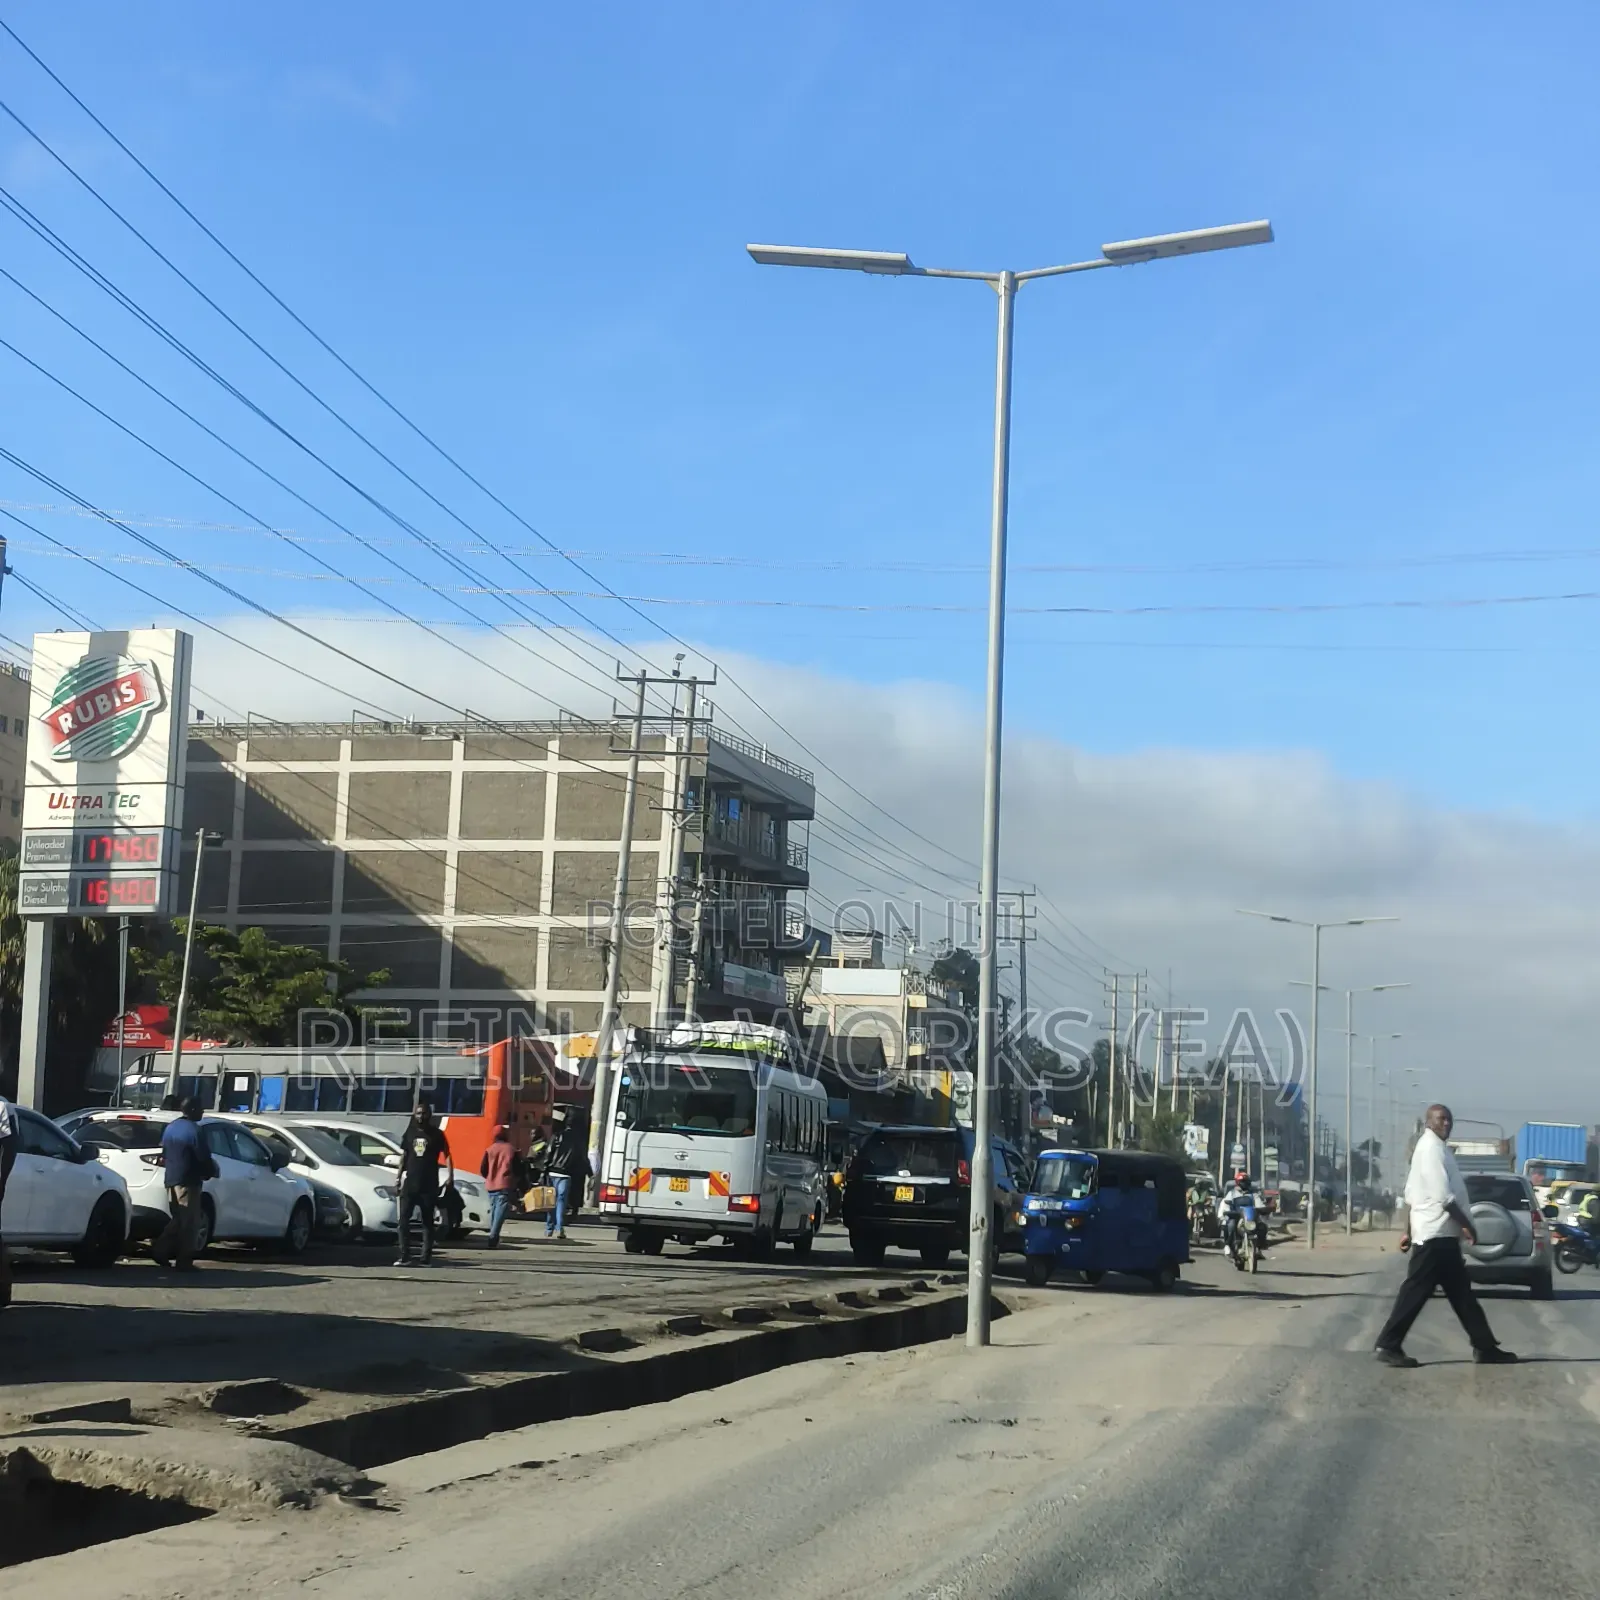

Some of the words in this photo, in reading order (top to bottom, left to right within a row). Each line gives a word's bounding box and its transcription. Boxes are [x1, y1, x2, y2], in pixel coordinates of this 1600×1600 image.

[57, 680, 136, 734] RUBIS
[48, 792, 103, 809] ULTRA
[26, 838, 66, 850] Unleaded
[26, 853, 61, 862] Premium
[23, 893, 48, 905] Diesel
